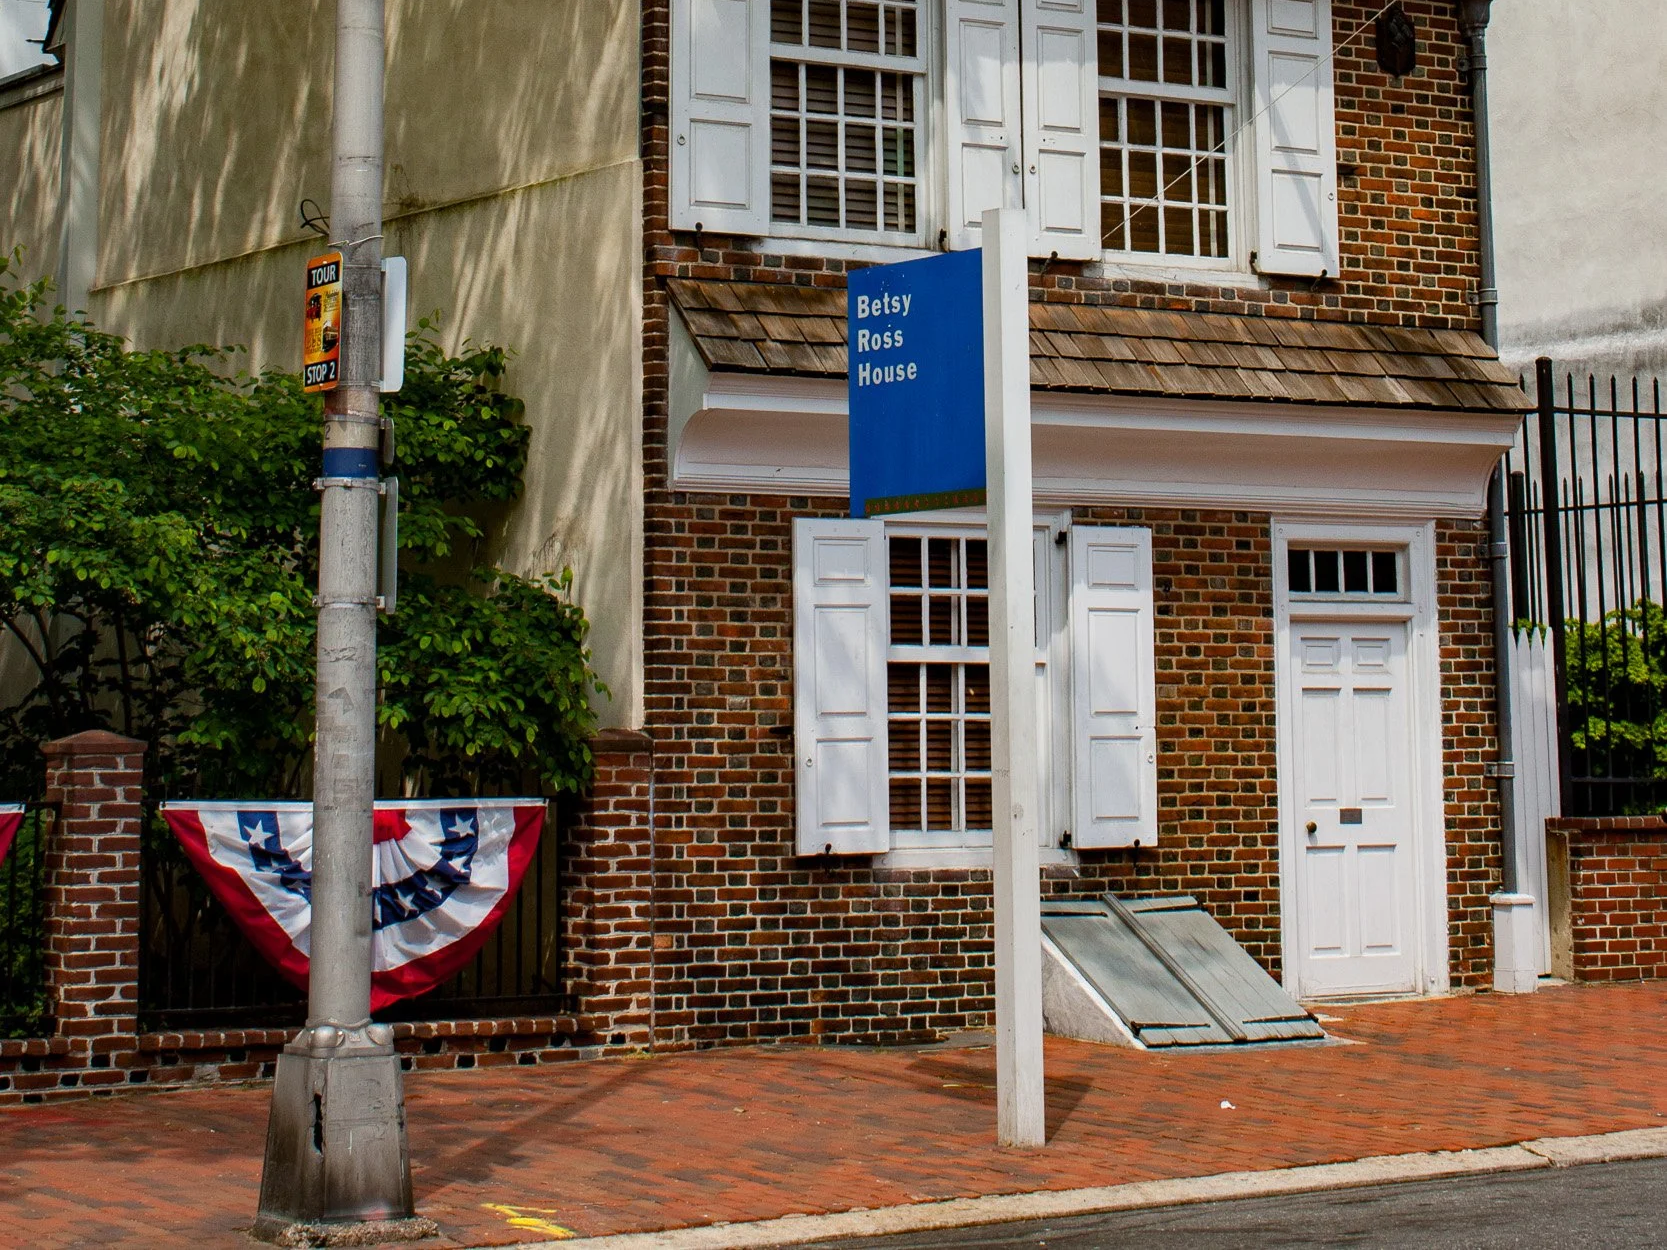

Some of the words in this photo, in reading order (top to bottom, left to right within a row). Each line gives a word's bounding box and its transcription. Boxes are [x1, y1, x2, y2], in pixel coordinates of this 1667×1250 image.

[311, 264, 336, 286] TOUR
[857, 292, 911, 318] Betsy
[858, 329, 904, 353] Ross
[307, 363, 327, 384] STOP
[329, 361, 336, 379] 2
[858, 362, 917, 386] House
